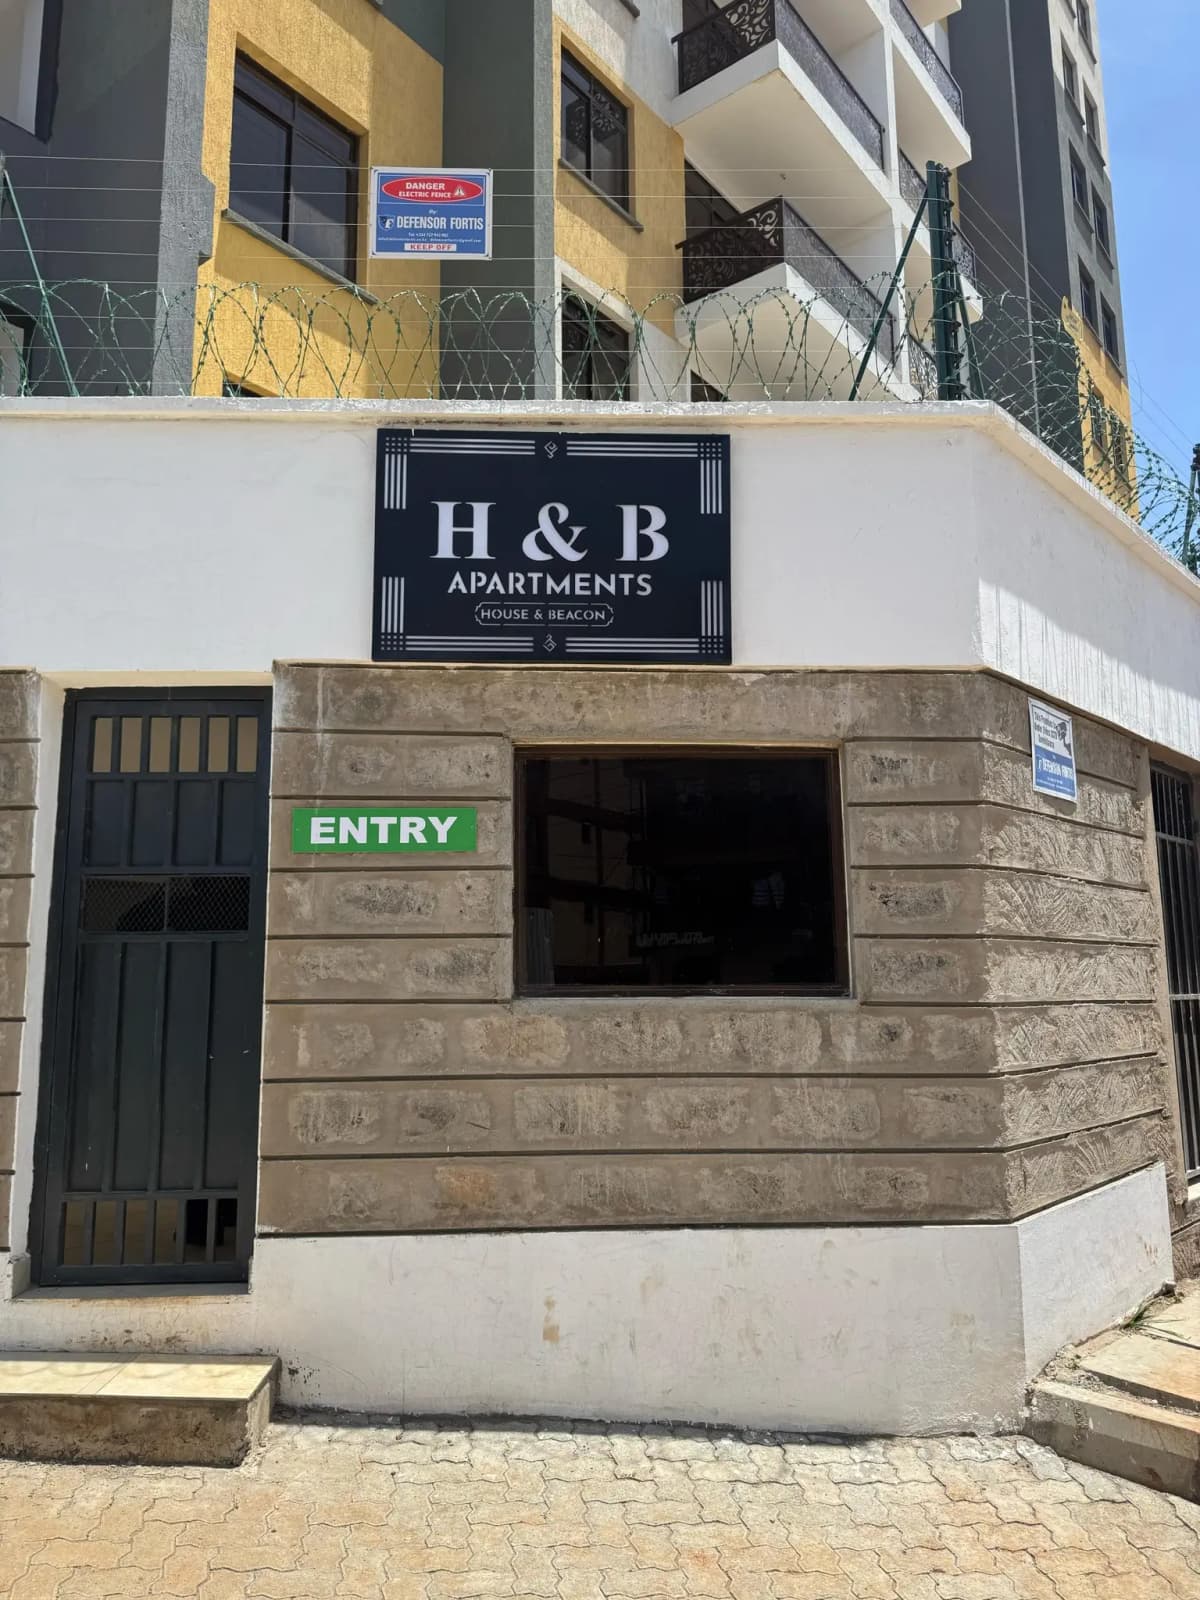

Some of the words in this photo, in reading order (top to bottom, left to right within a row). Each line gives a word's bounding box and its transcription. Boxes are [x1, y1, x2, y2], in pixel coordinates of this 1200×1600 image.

[405, 182, 445, 190] DANGER
[396, 216, 446, 229] DEFENSOR
[450, 217, 484, 230] FORTIS
[429, 501, 496, 560] H
[521, 502, 588, 562] &
[616, 504, 670, 562] B
[447, 570, 652, 596] APARTMENTS
[481, 608, 529, 620] HOUSE
[534, 609, 544, 620] &
[548, 609, 605, 621] BEACON
[310, 816, 458, 844] ENTRY
